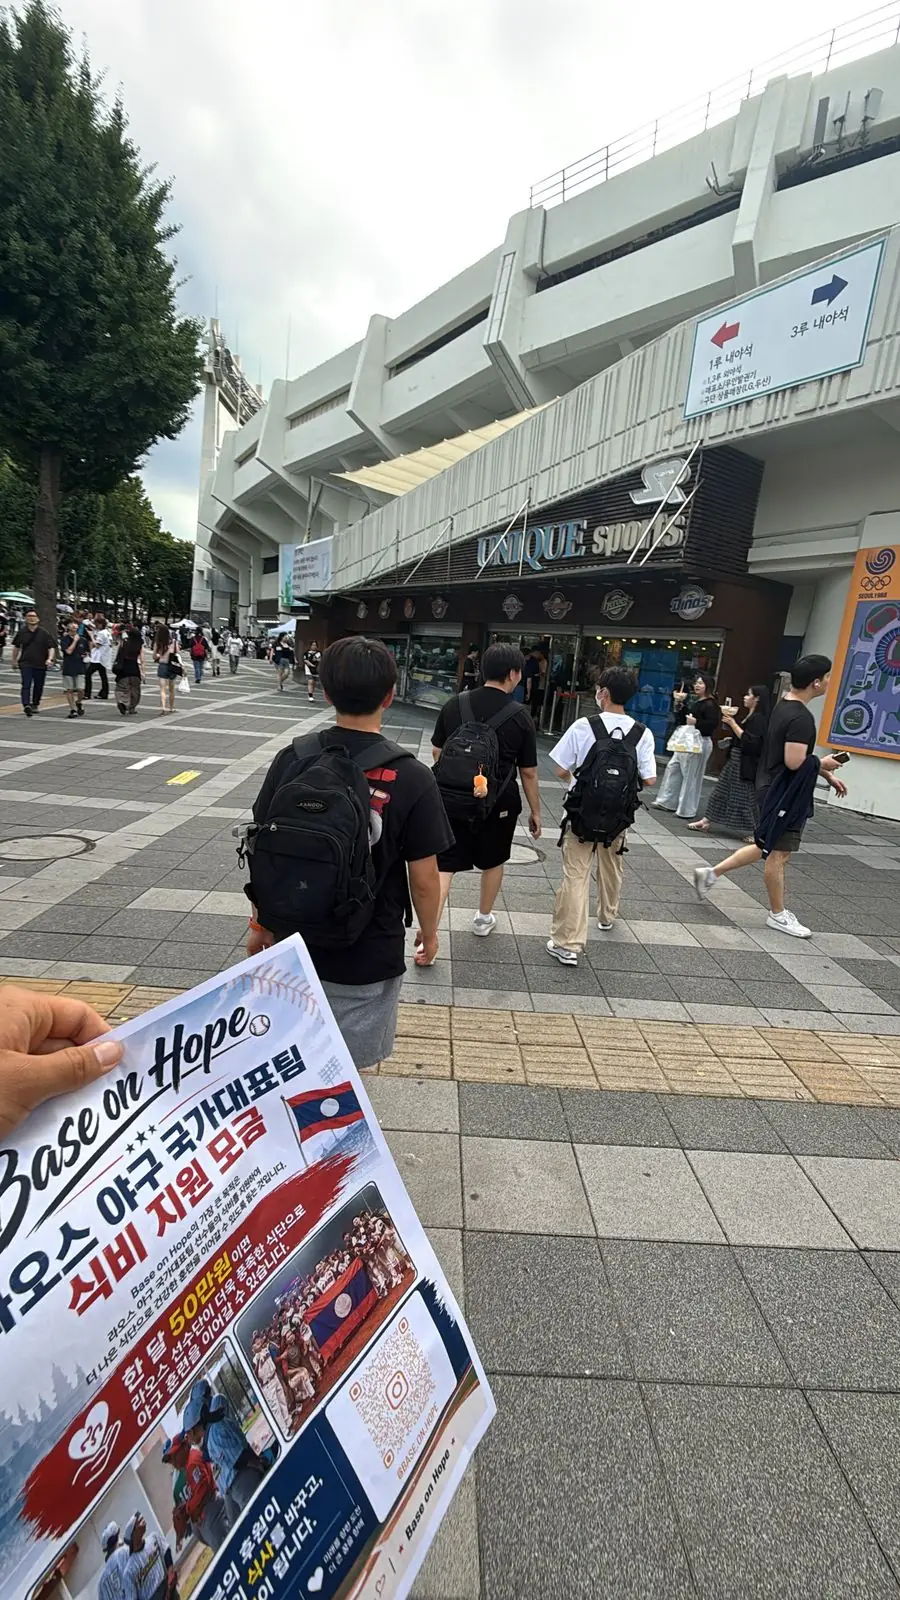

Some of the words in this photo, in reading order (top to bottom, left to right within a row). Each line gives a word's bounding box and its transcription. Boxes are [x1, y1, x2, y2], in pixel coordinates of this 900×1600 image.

[709, 356, 722, 371] 1루
[725, 343, 753, 363] 내야석
[790, 321, 809, 338] 3루
[813, 306, 849, 330] 내야석
[476, 519, 588, 571] UNIQUE
[592, 511, 687, 556] sports
[103, 1072, 144, 1120] on
[148, 1006, 250, 1094] Hope
[96, 1149, 163, 1225] 야구
[160, 1044, 307, 1161] 국가대표팀
[68, 1221, 148, 1317] 식비
[145, 1157, 214, 1237] 지원
[206, 1106, 267, 1175] 모금
[130, 1270, 156, 1299] Base
[156, 1256, 169, 1271] on
[169, 1221, 199, 1257] Hope의
[199, 1205, 214, 1224] 가장
[86, 1368, 98, 1385] 더
[98, 1346, 118, 1372] 나은
[119, 1306, 155, 1348] 식단으로
[153, 1279, 178, 1310] 건강한
[178, 1254, 201, 1283] 훈련을
[201, 1229, 221, 1255] 이어갈
[221, 1223, 229, 1232] 수
[256, 1161, 287, 1190] 것입니다.
[107, 1309, 137, 1342] 라오스
[137, 1287, 154, 1310] 야구
[156, 1243, 194, 1289] 국가대표팀
[194, 1214, 221, 1247] 선수들의
[130, 1362, 170, 1412] 라오스
[171, 1303, 215, 1363] 선수단이
[214, 1278, 236, 1307] 더욱
[236, 1242, 266, 1282] 풍족한
[266, 1203, 307, 1246] 식단으로
[121, 1356, 145, 1394] 한
[146, 1330, 167, 1364] 달
[137, 1389, 164, 1427] 야구
[165, 1343, 201, 1395] 훈련을
[202, 1301, 235, 1345] 이어갈
[235, 1290, 246, 1304] 수
[245, 1242, 290, 1292] 있습니다.
[239, 1495, 281, 1565] 후원이
[284, 1474, 323, 1526] 바꾸고,
[405, 1504, 425, 1542] Base
[424, 1483, 434, 1503] on
[432, 1449, 450, 1485] Hope
[272, 1516, 317, 1580] 됩니다.
